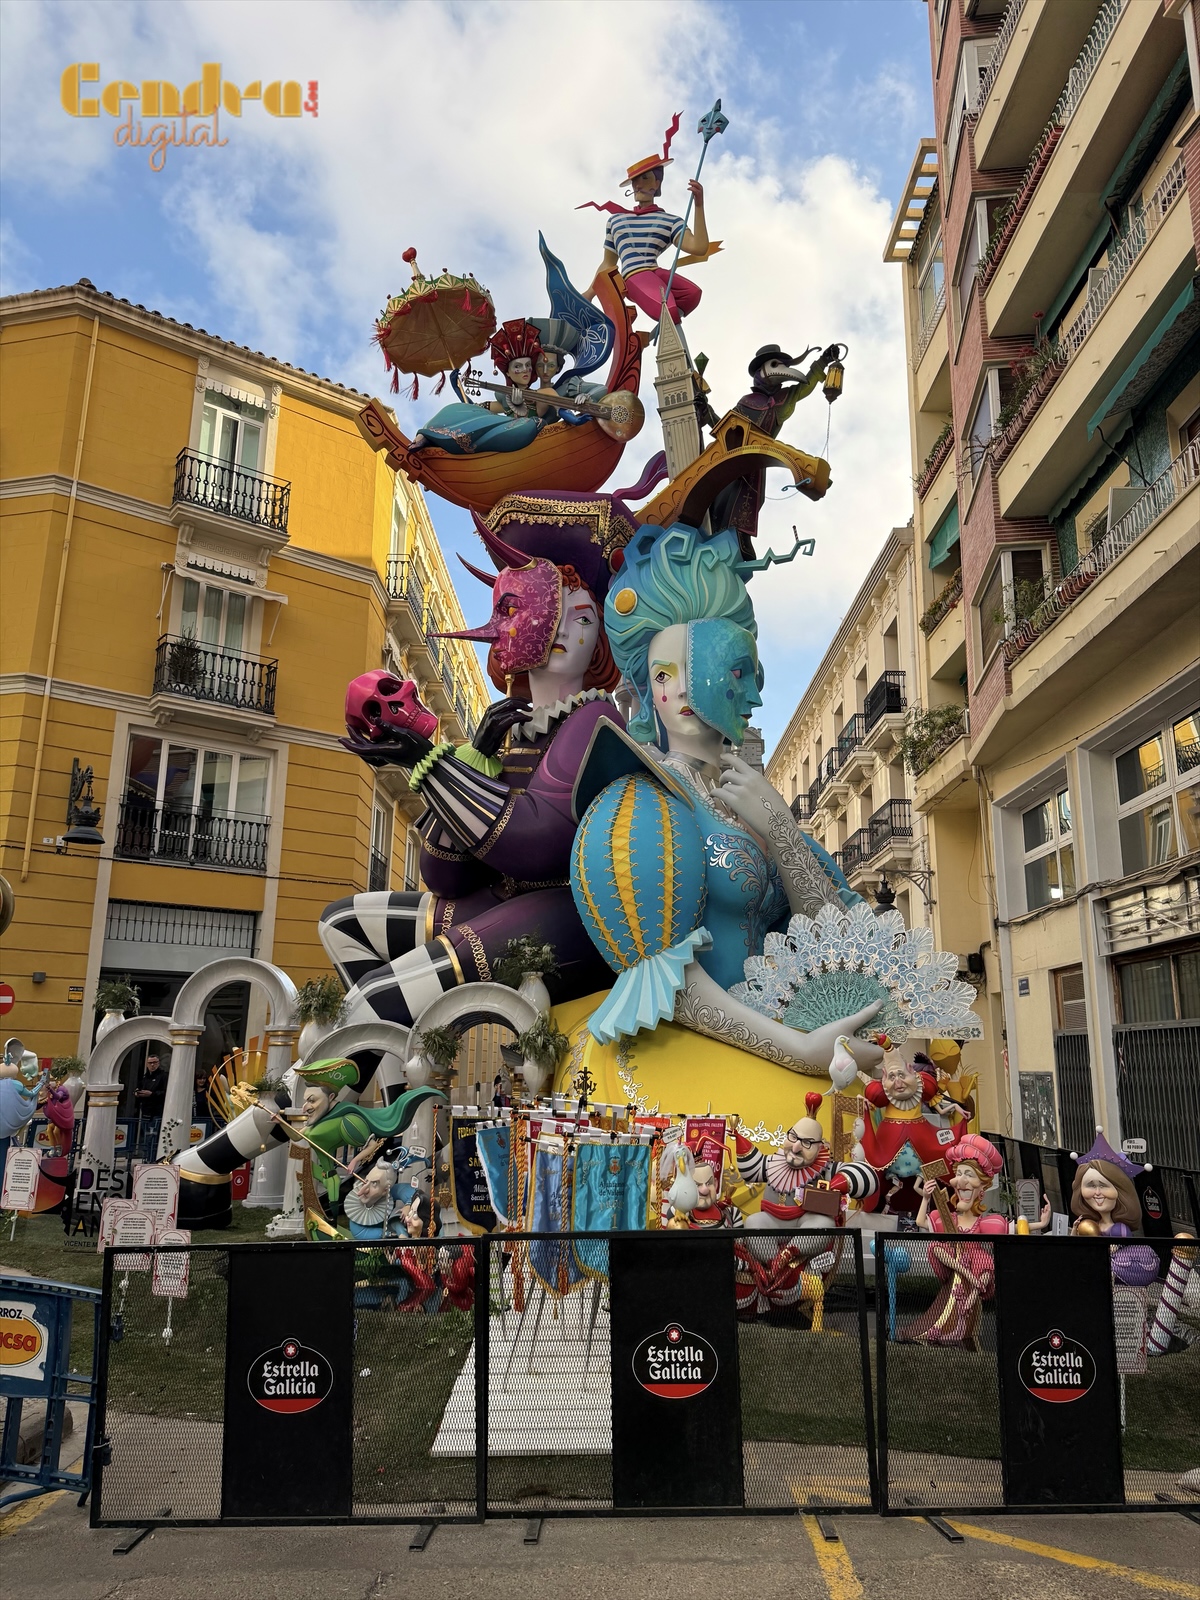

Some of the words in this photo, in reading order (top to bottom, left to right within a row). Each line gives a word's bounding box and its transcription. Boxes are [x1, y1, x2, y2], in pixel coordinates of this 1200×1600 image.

[328, 1071, 347, 1081] VOX
[79, 1168, 125, 1191] DES
[63, 1240, 92, 1248] VICENTE
[0, 1332, 37, 1352] csa
[646, 1345, 704, 1363] Estrella
[1031, 1351, 1083, 1369] Estrella
[262, 1360, 319, 1378] Estrella
[648, 1362, 703, 1380] Galicia
[1033, 1367, 1082, 1385] Galicia
[263, 1378, 316, 1396] Galicia
